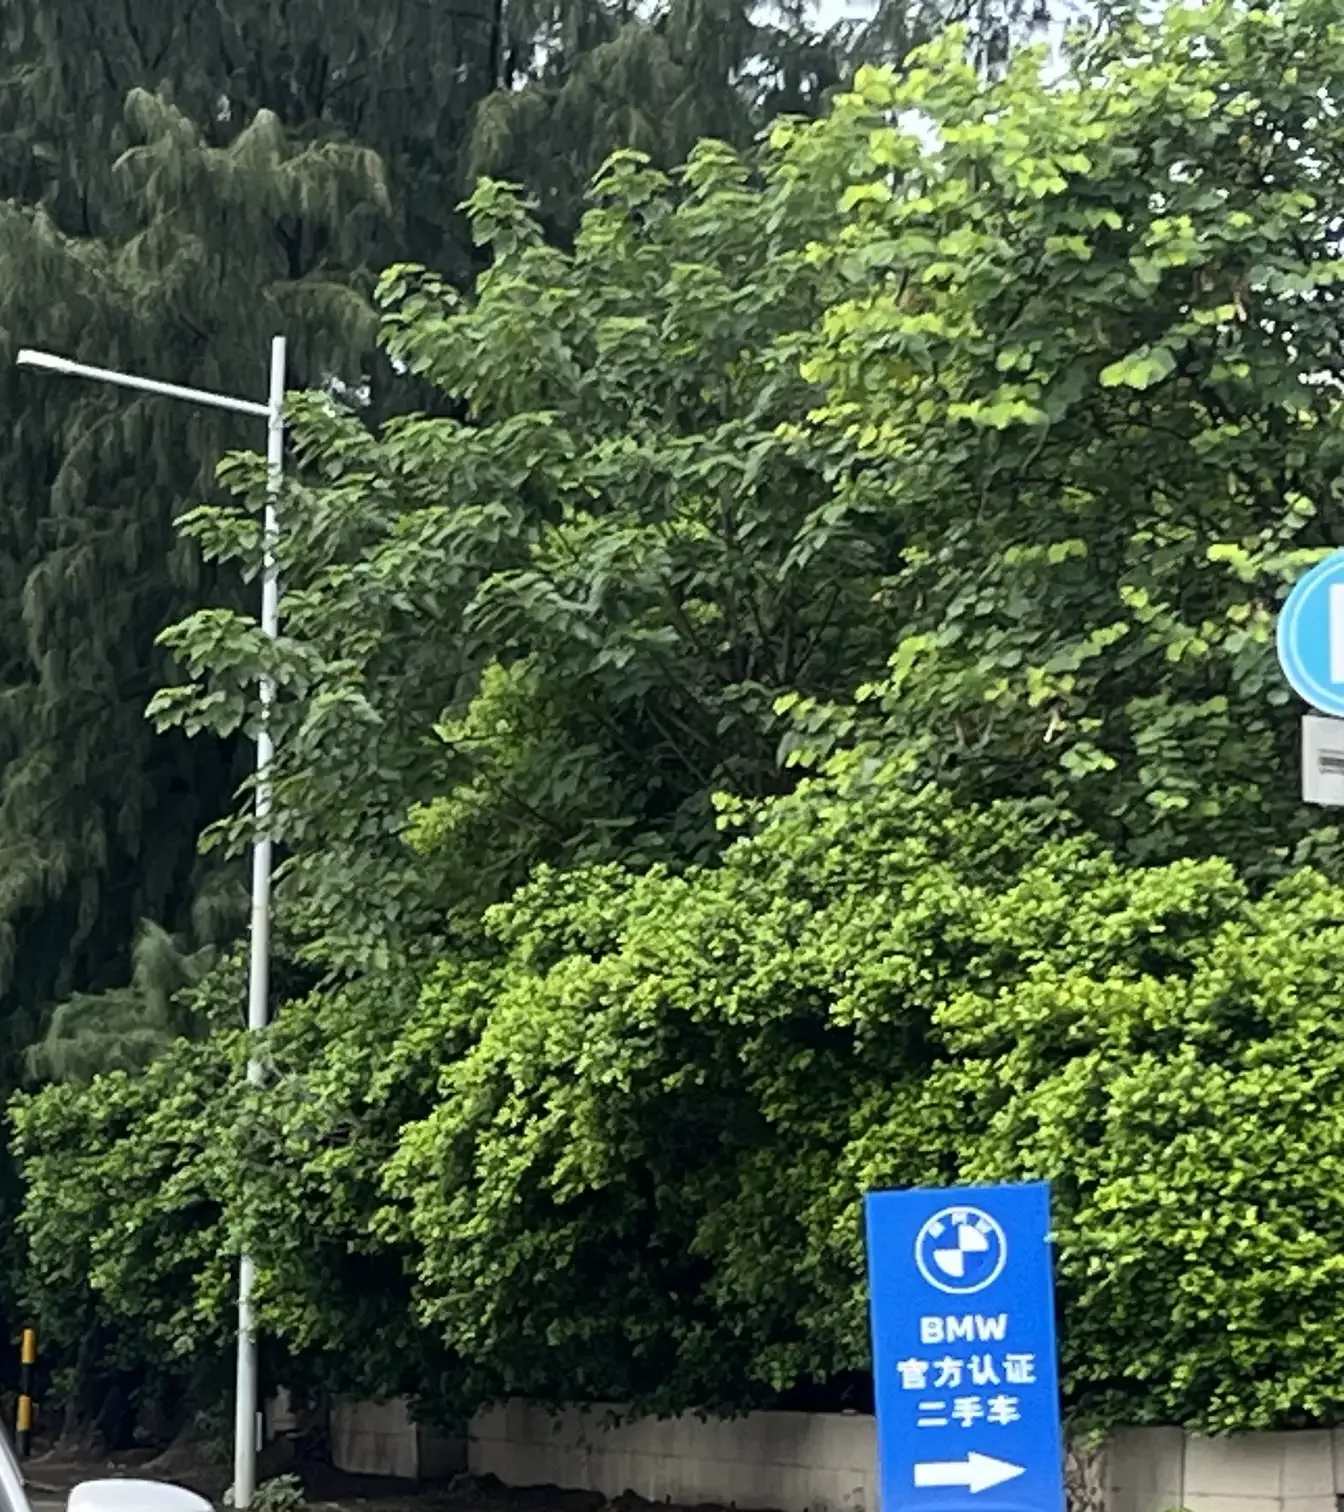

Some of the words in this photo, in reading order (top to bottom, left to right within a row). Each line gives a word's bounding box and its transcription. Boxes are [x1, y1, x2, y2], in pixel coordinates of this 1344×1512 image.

[920, 1313, 1008, 1344] BMW
[896, 1353, 1037, 1390] 官方认证
[916, 1394, 1022, 1428] 二手车
